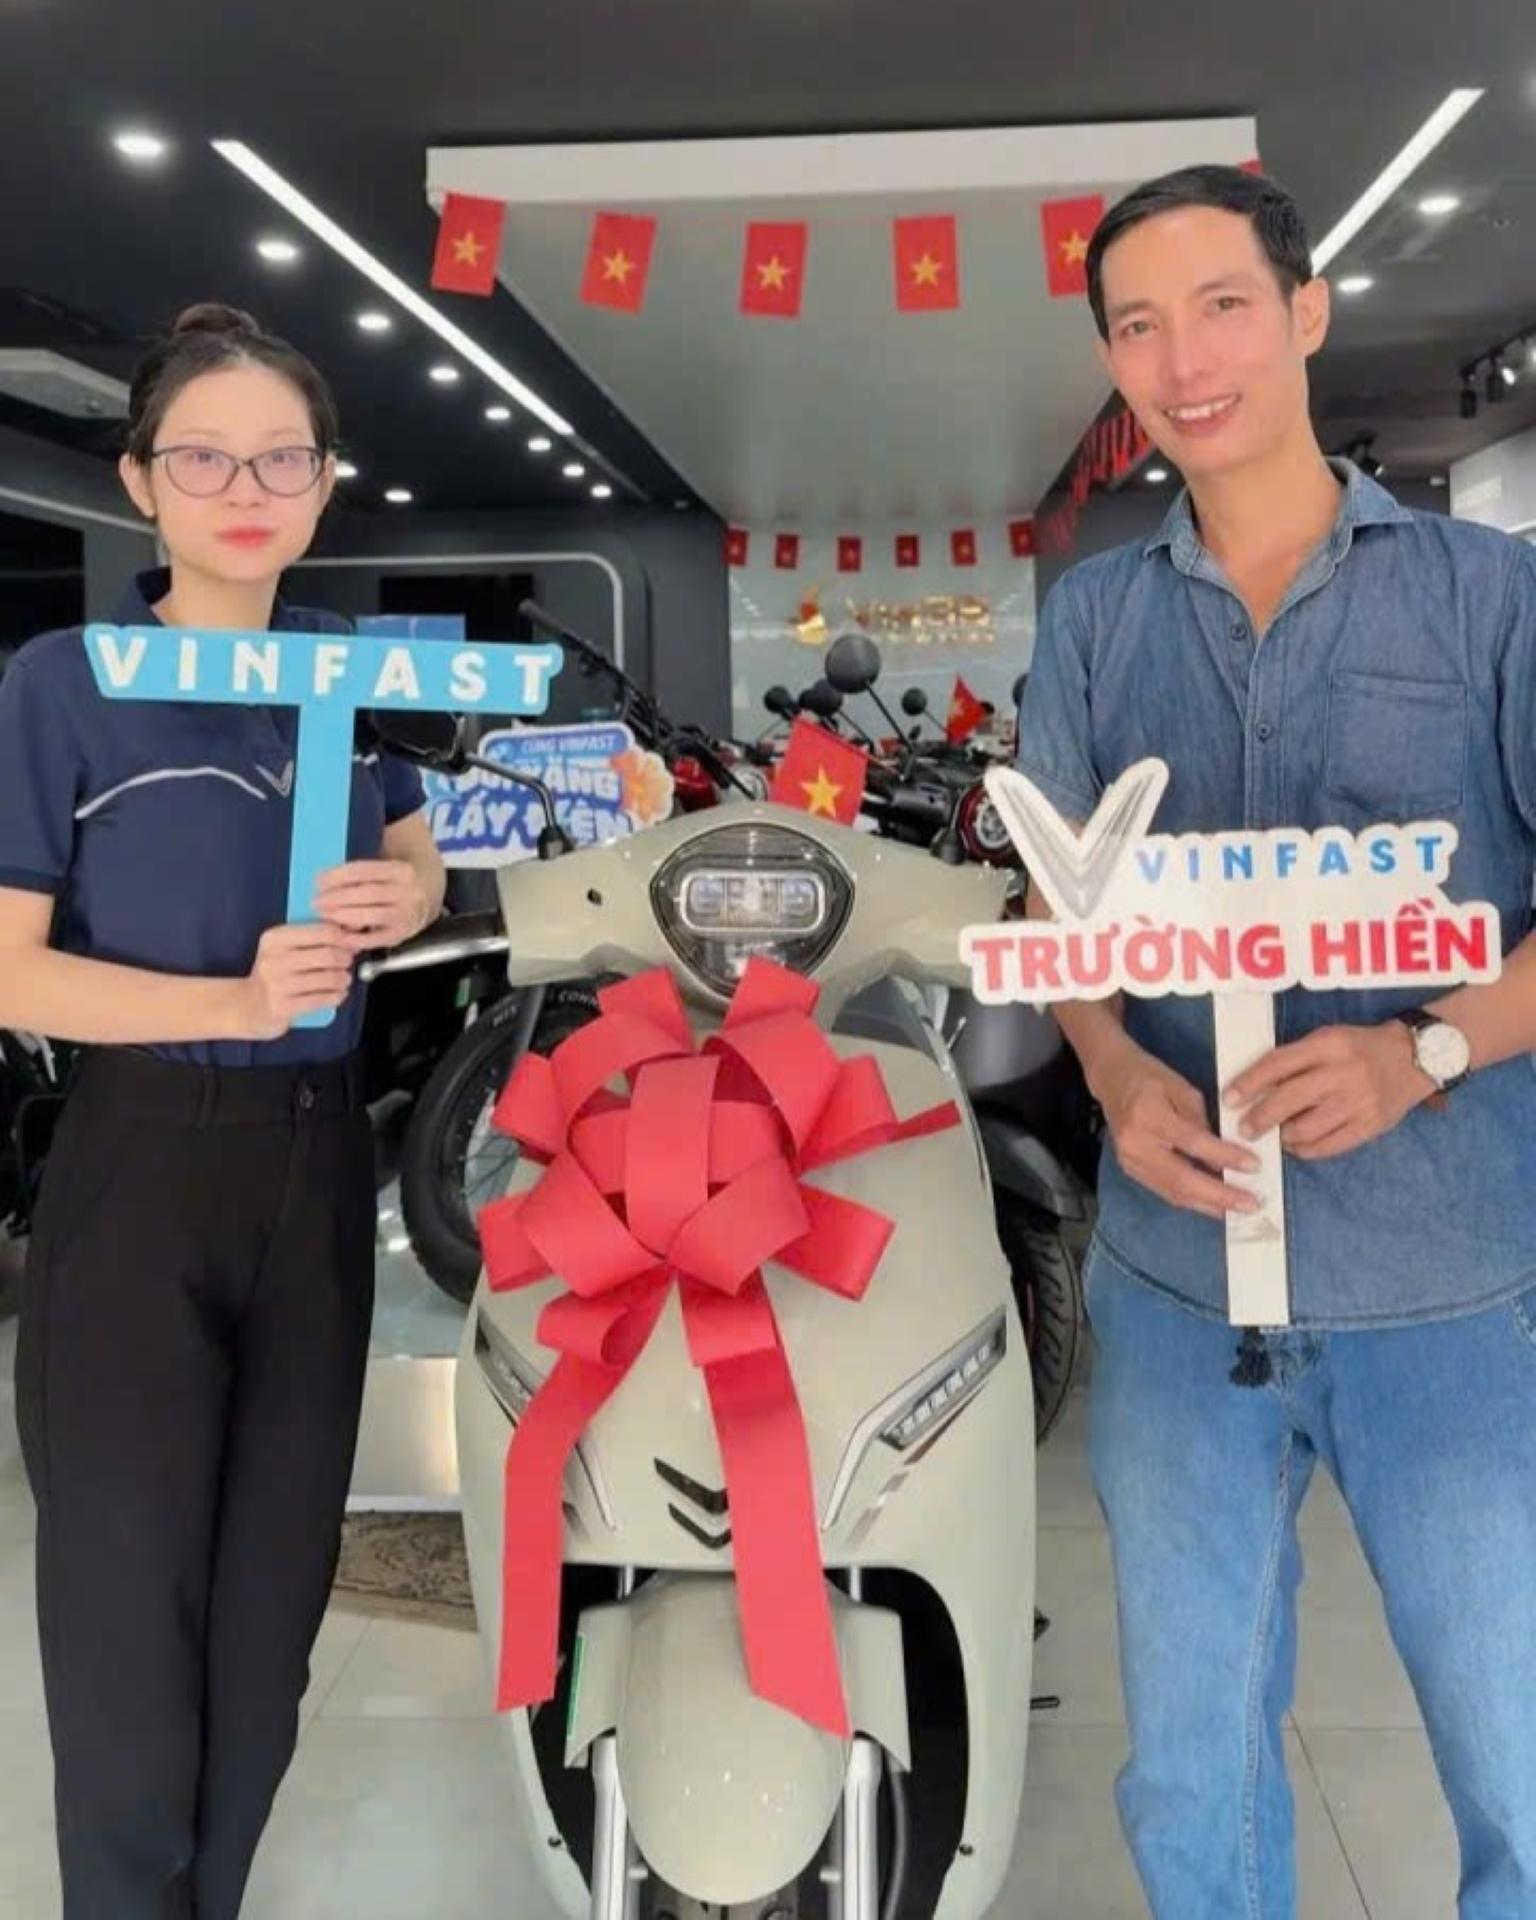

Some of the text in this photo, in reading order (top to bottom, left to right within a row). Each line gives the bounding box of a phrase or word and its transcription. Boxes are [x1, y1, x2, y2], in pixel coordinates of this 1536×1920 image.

[97, 635, 553, 703] VINFAST
[1134, 836, 1443, 883] VINFAST
[972, 898, 1488, 991] TRƯỜNG HIỀN
